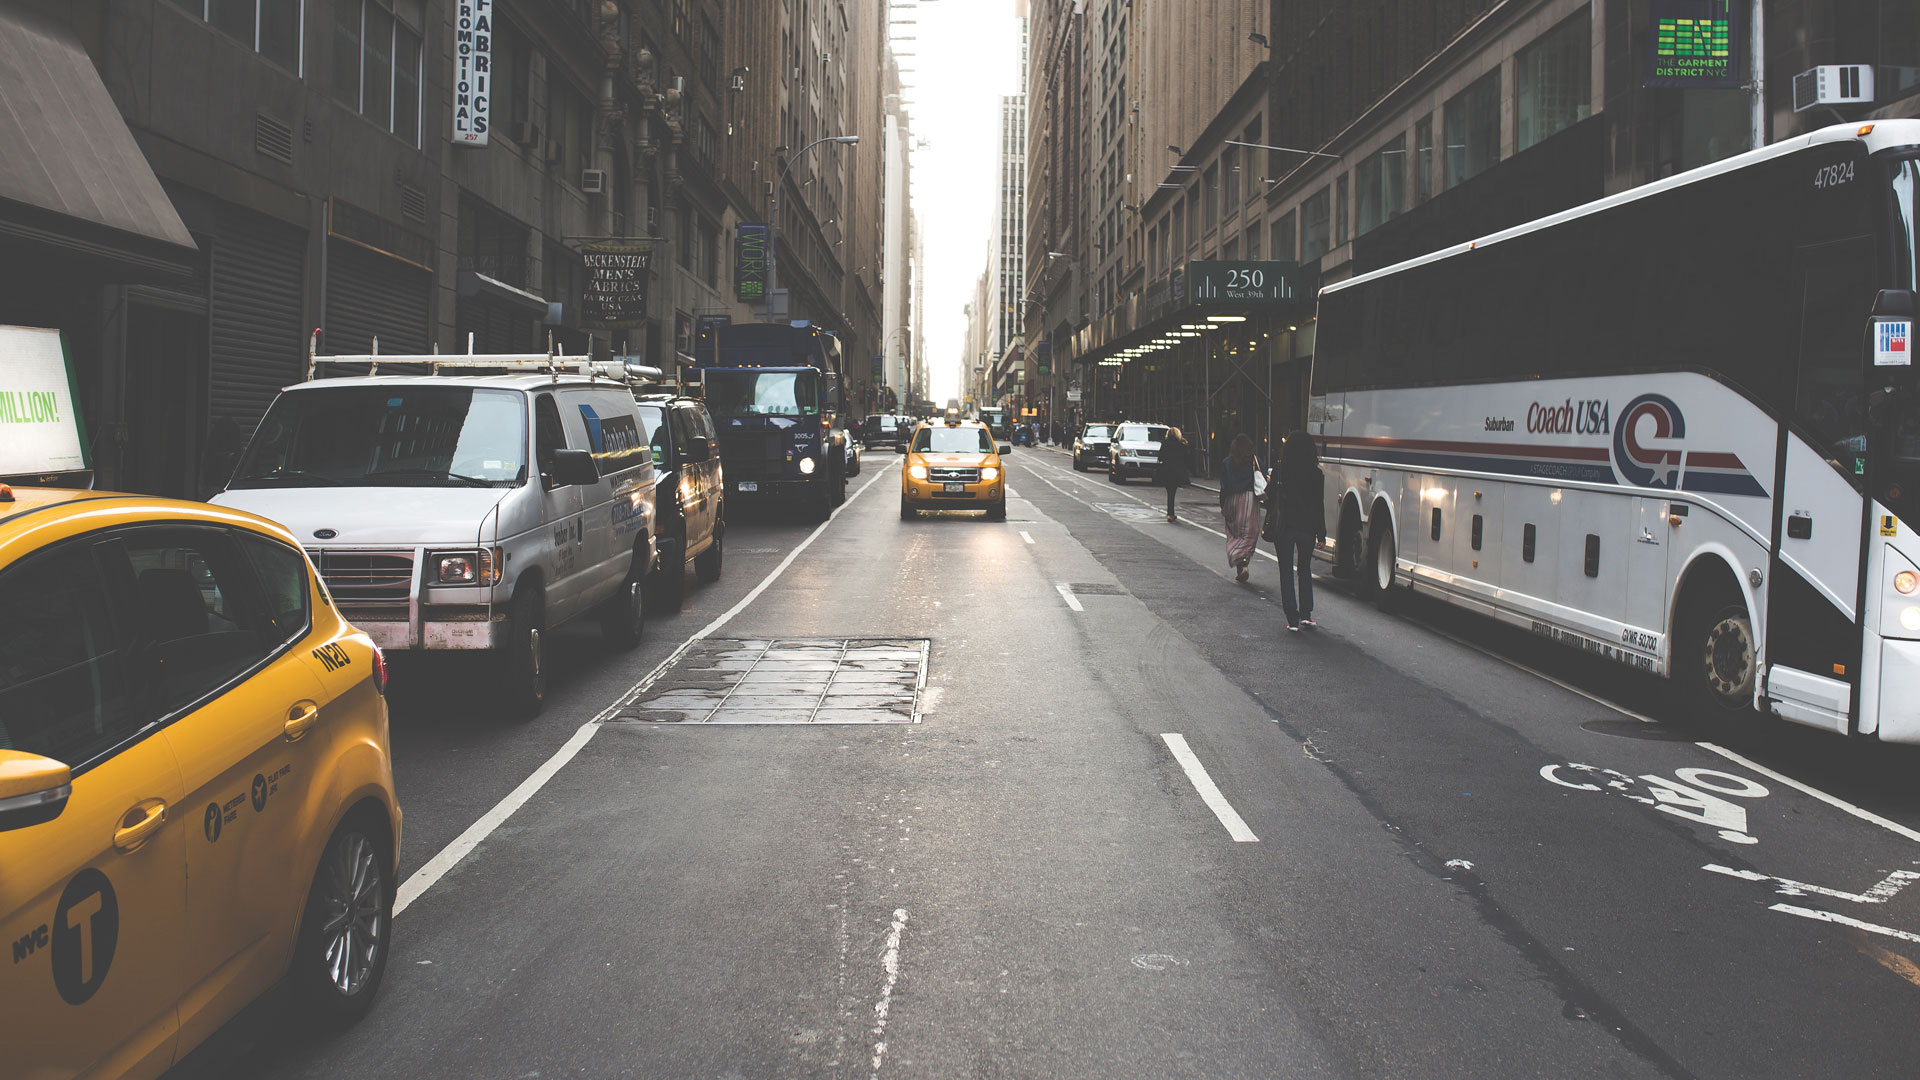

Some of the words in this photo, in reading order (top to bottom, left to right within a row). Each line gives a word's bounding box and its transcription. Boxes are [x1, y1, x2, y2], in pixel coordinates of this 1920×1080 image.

[457, 0, 472, 132] ROMOTIONAL
[474, 0, 490, 133] FABRICS
[1656, 68, 1704, 77] DISTRICT
[1706, 69, 1728, 77] NYC
[1658, 58, 1676, 66] THE
[1678, 58, 1728, 67] GARMENT
[1814, 160, 1855, 189] 47824
[741, 233, 765, 280] WORK
[593, 269, 635, 280] MEN'S
[1226, 269, 1264, 289] 250
[1226, 290, 1245, 298] West
[1247, 290, 1264, 298] 39th
[1485, 416, 1514, 432] Suburban
[1527, 397, 1574, 435] Coach
[1576, 399, 1611, 435] USA
[312, 642, 351, 673] 1N20
[12, 923, 49, 965] NYC
[66, 890, 102, 985] T
